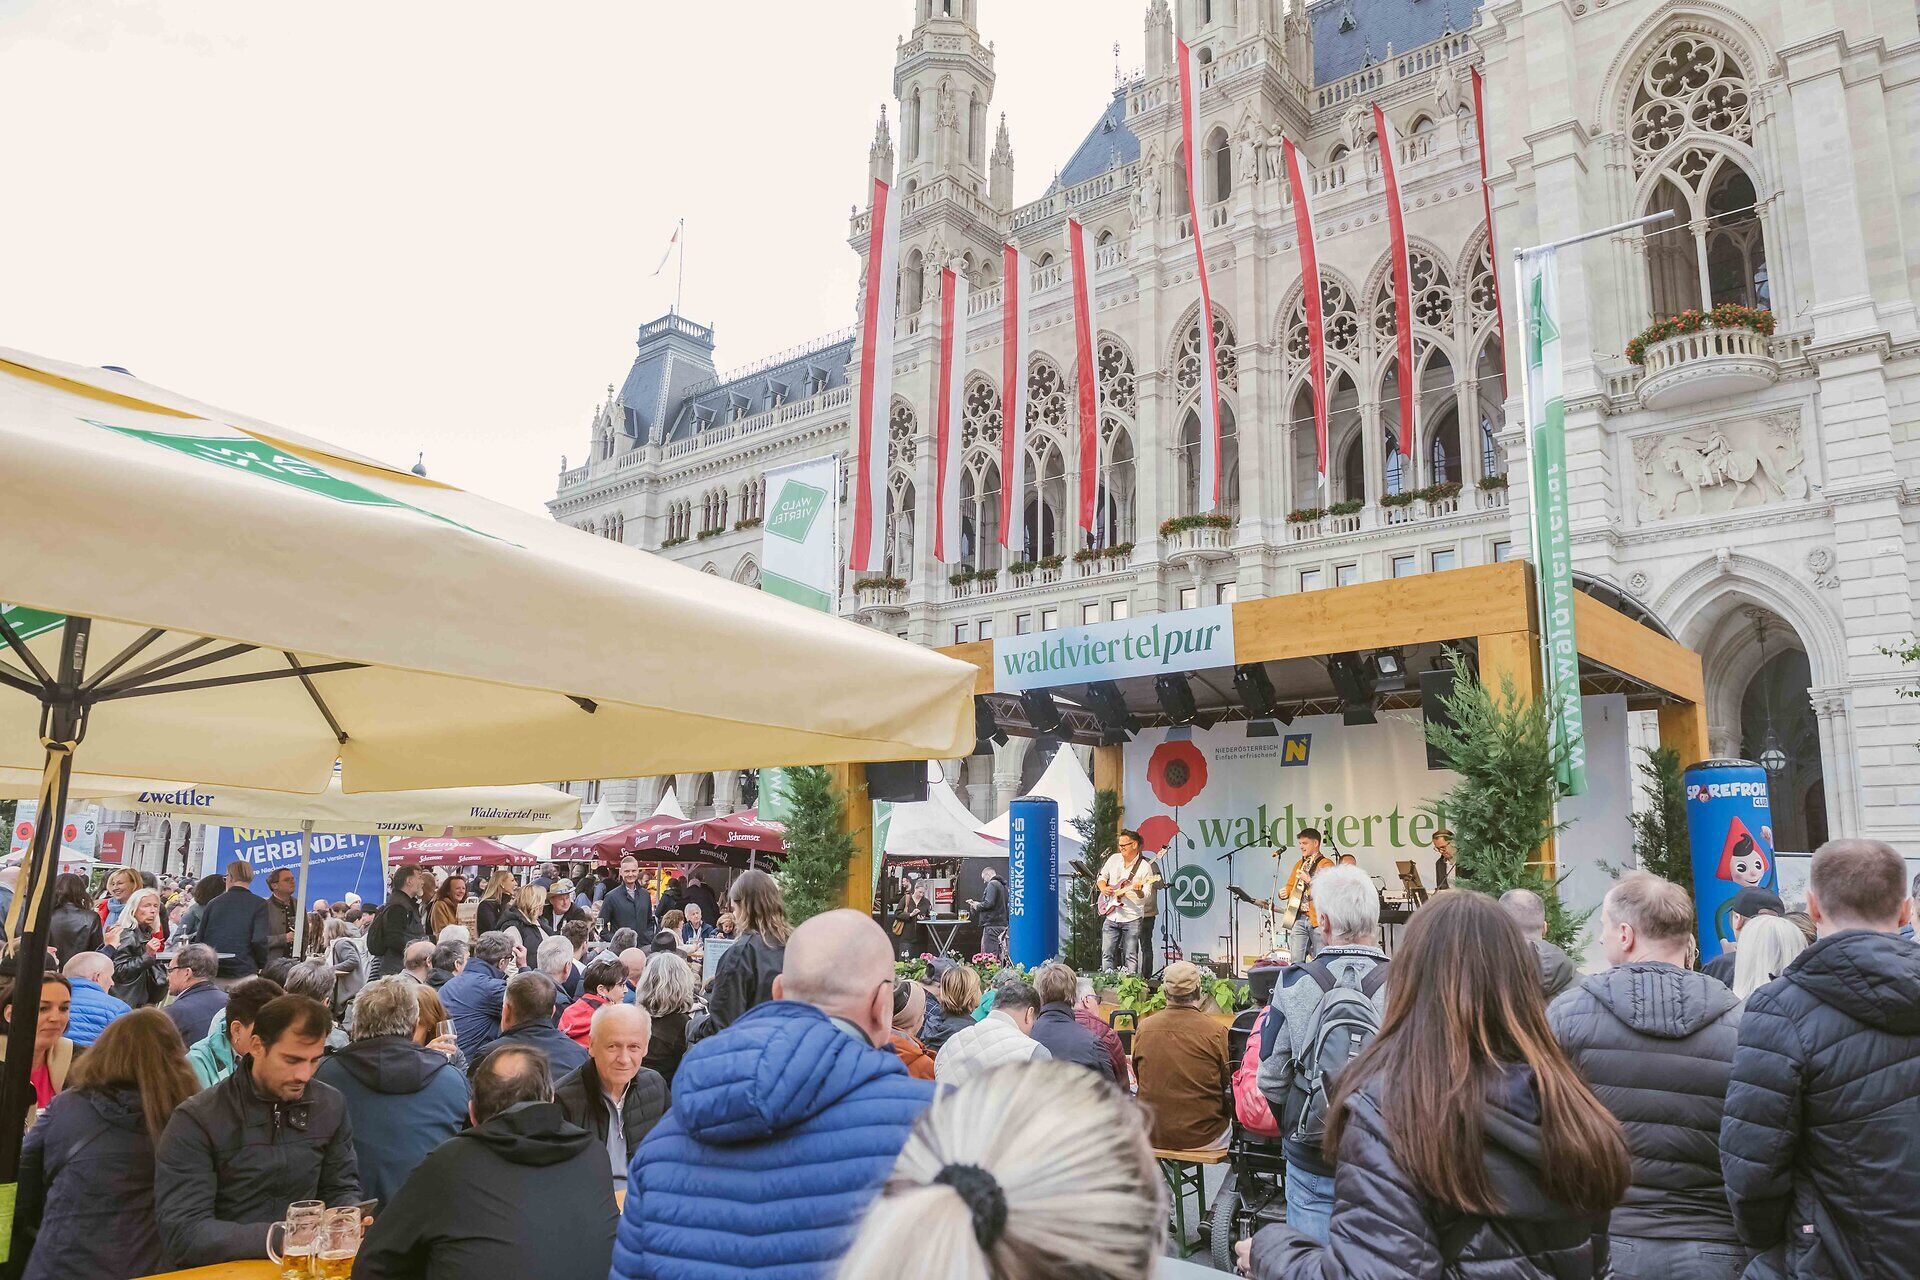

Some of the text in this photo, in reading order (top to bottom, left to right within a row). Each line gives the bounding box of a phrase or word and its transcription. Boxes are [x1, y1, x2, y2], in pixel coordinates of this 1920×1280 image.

[1215, 744, 1279, 753] NIEDERÖSTERREICH
[1215, 752, 1279, 761] Einfach erfrischend.
[470, 806, 532, 819] Waldviertel
[1049, 817, 1057, 892] #glaubandich
[1014, 834, 1025, 917] SPARKASSE
[1174, 874, 1210, 907] 20
